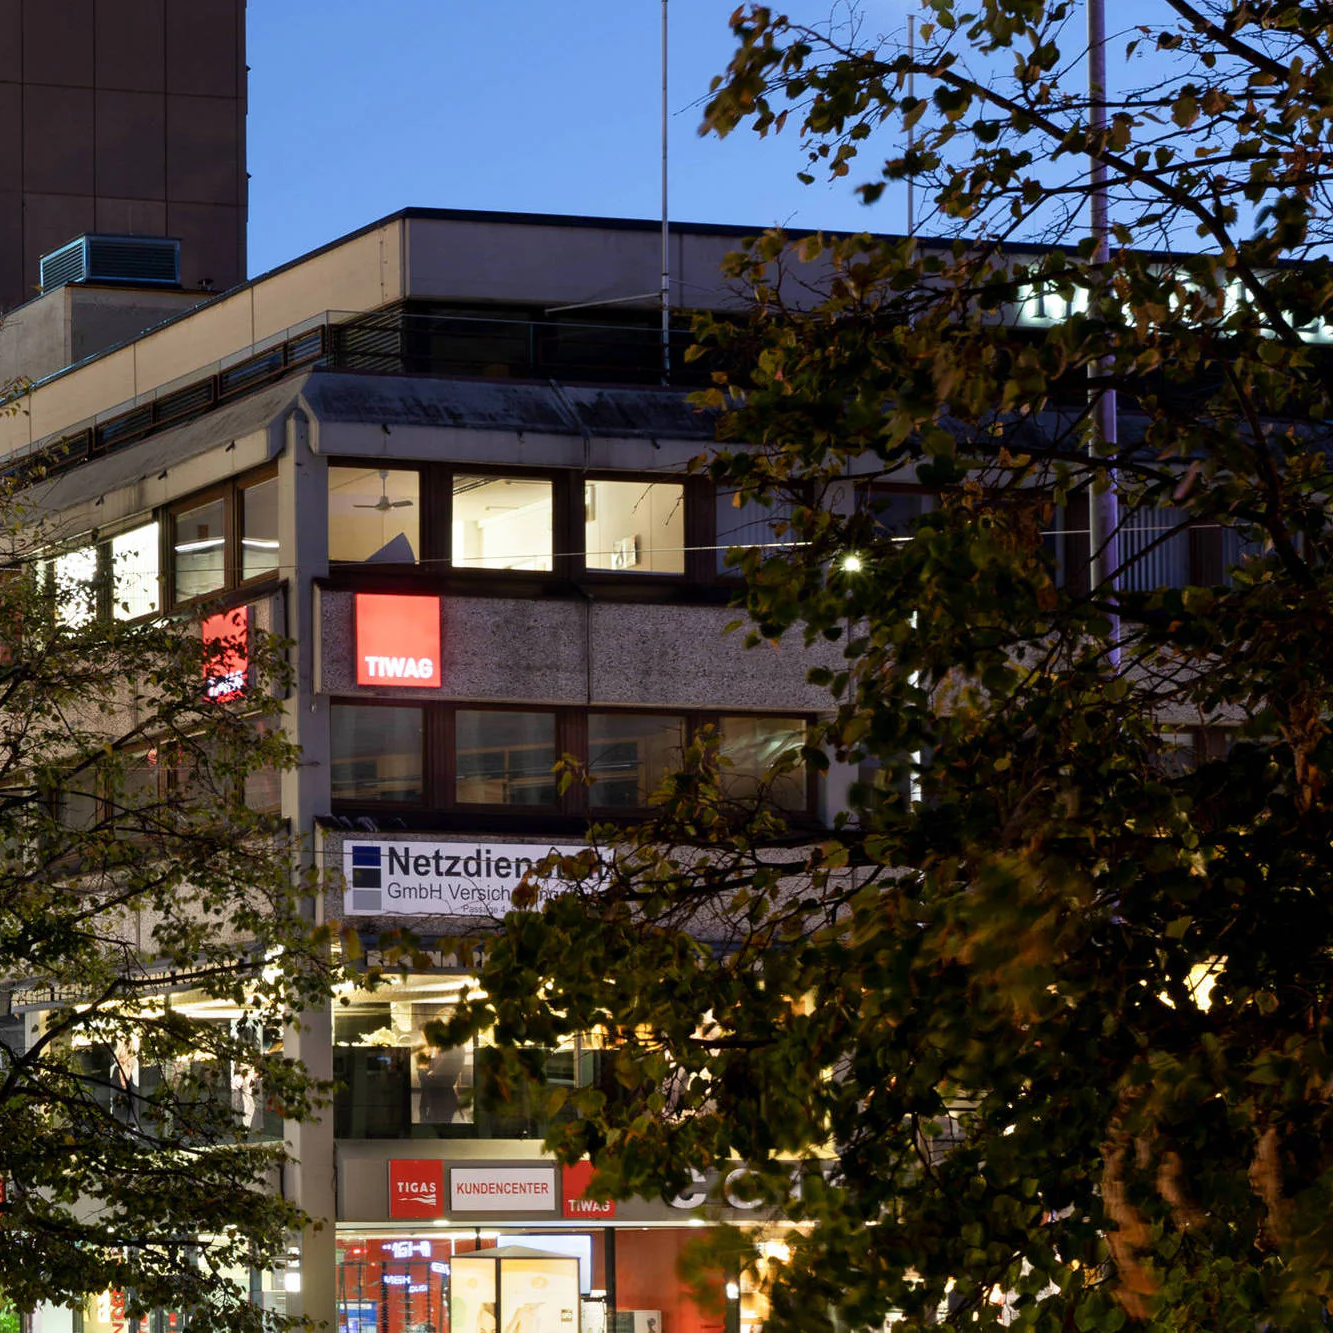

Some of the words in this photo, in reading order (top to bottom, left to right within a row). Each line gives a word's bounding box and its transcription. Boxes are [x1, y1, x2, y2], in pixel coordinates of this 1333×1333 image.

[364, 655, 434, 679] TIWAG
[387, 883, 442, 900] GmbH
[396, 1181, 437, 1194] TIGAS
[456, 1182, 549, 1195] KUNDENCENTER
[567, 1198, 612, 1212] TIWAG
